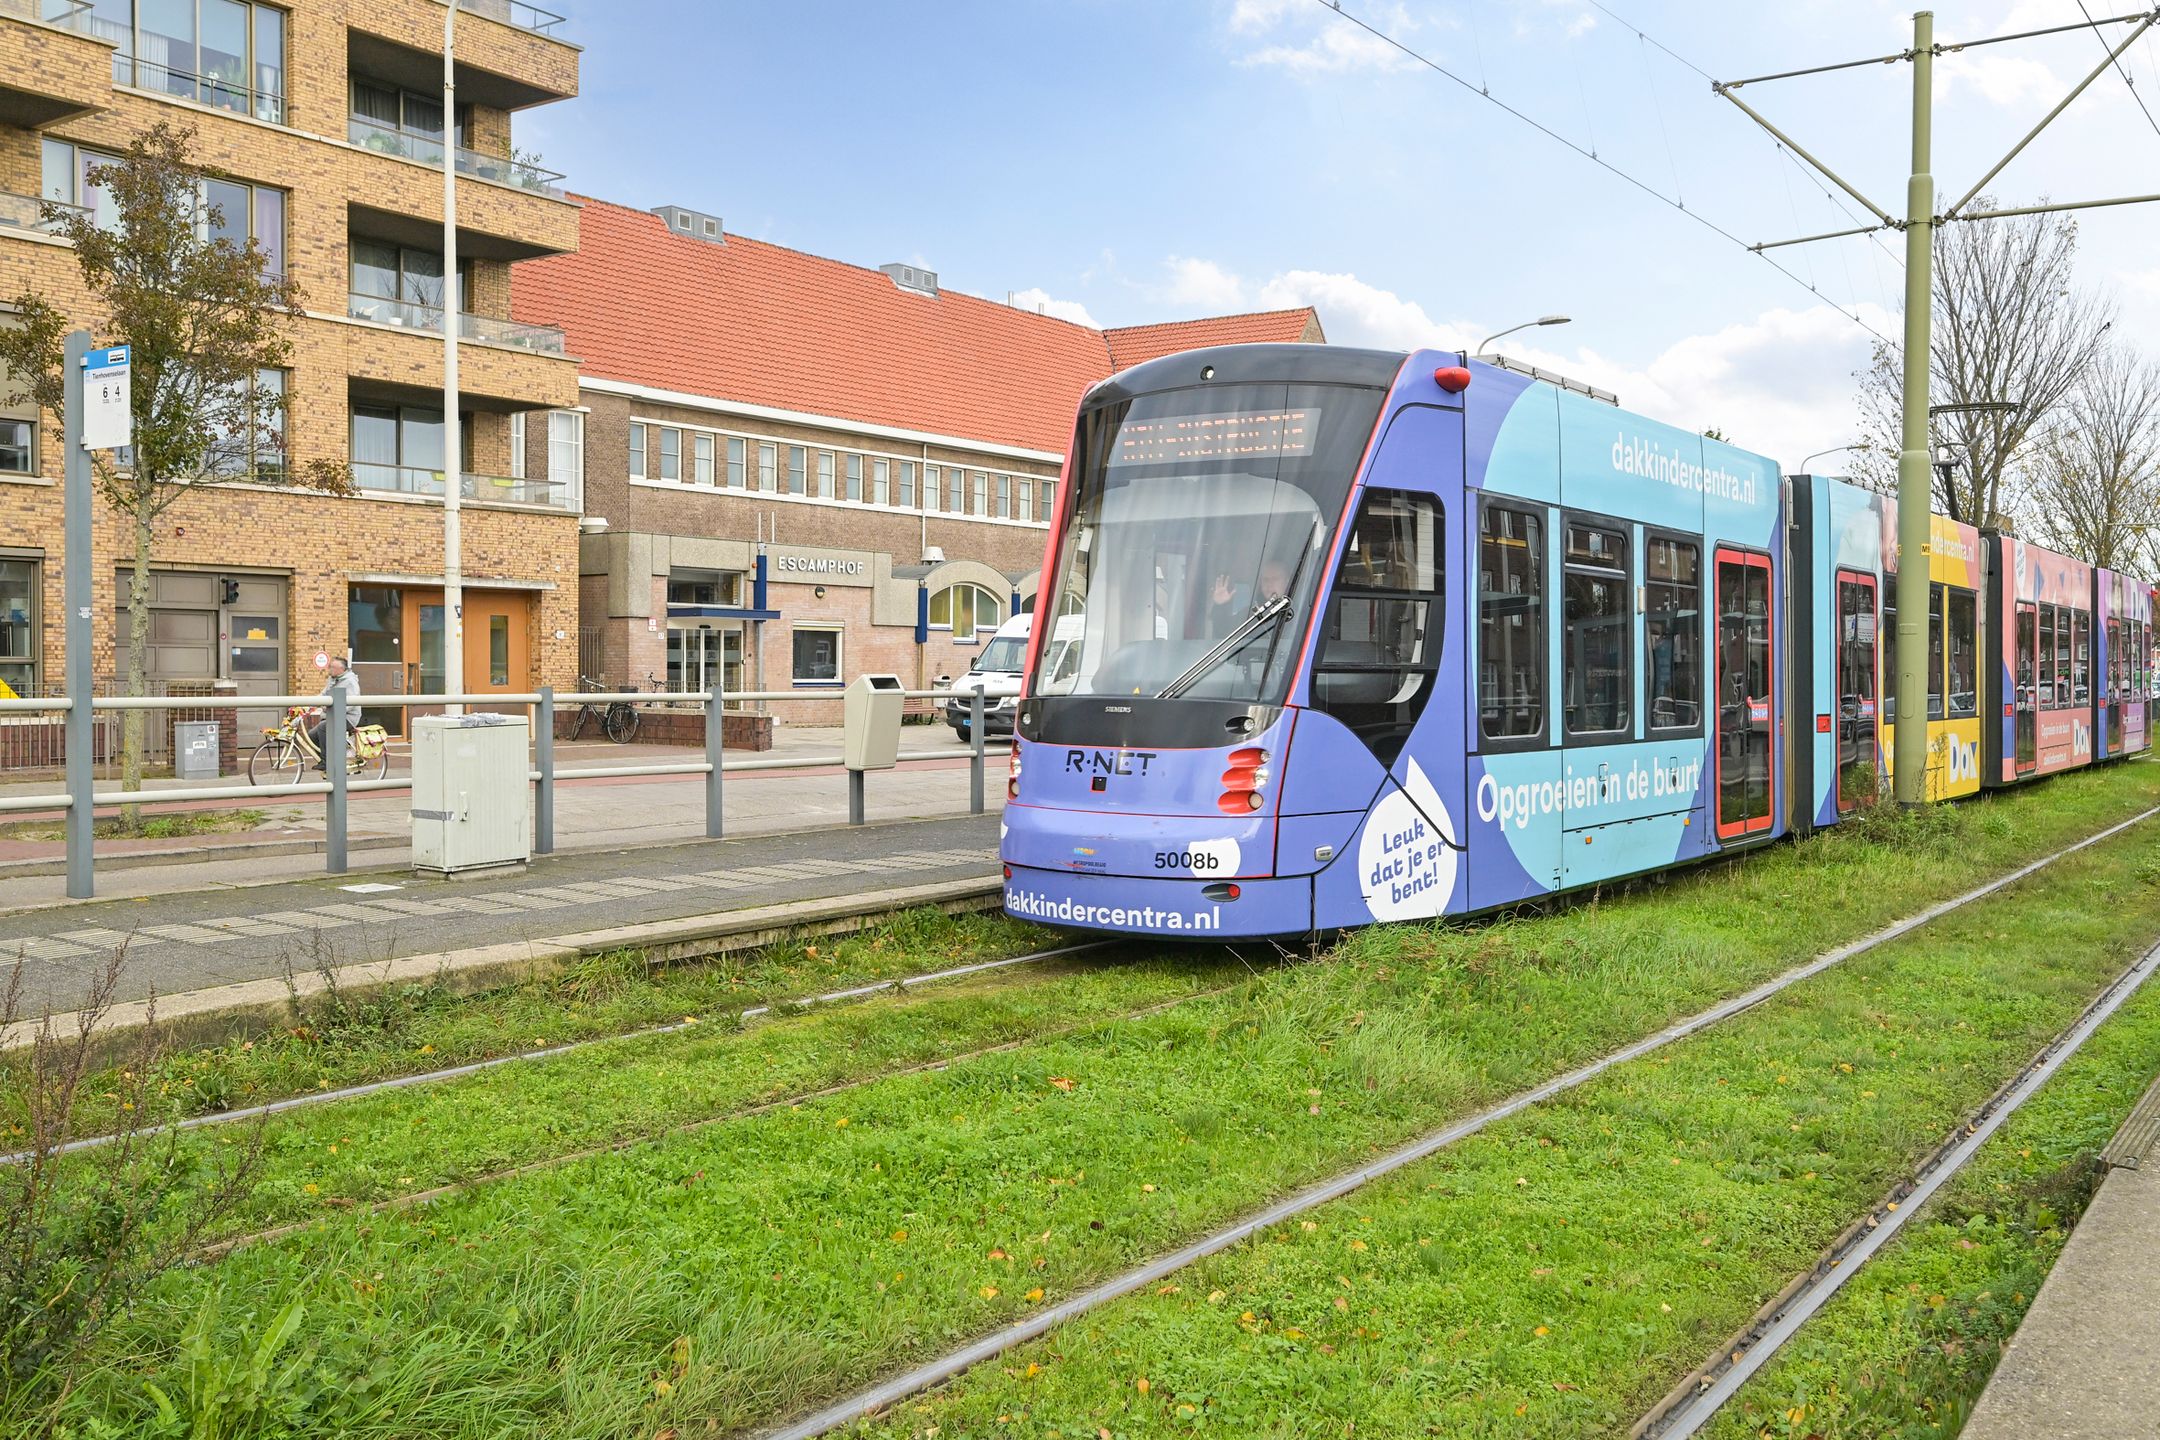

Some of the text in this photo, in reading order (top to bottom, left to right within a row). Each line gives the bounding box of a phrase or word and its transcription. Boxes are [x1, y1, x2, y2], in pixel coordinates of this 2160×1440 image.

[93, 369, 127, 380] Tienhovenselaan
[102, 385, 120, 398] 6 4
[1612, 431, 1756, 505] dakkindercentra.nl
[778, 556, 864, 576] ESCAMPHOF
[1476, 756, 1699, 832] Opgroeien in de buurt
[1383, 818, 1425, 855] Leuk
[1154, 851, 1219, 870] 5008b
[1371, 840, 1446, 887] dat je er
[1391, 862, 1438, 904] bent!
[1006, 887, 1220, 930] dakkindercentra.nl
